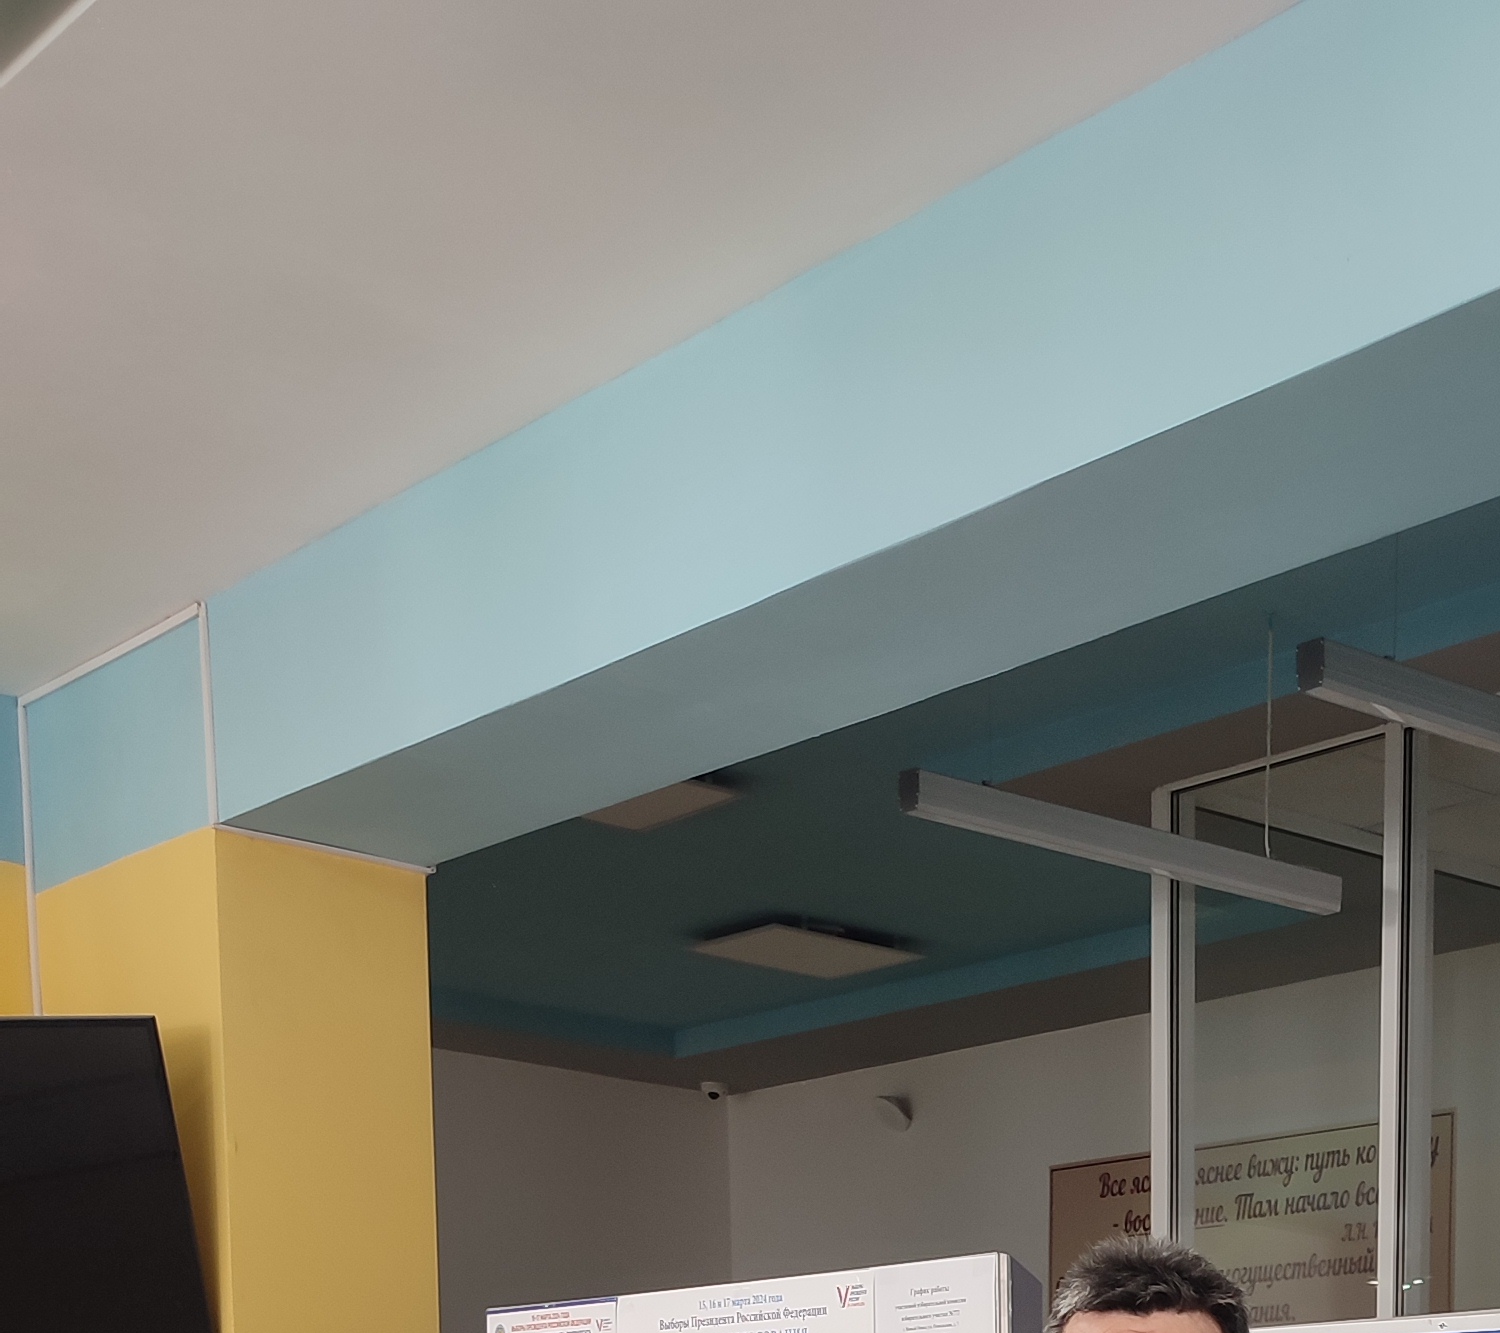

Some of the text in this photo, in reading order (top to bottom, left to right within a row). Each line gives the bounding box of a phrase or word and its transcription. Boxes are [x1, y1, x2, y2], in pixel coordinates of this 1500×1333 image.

[1098, 1172, 1127, 1199] Все
[1195, 1162, 1243, 1186] яснее
[1246, 1154, 1300, 1188] вижу:
[1304, 1147, 1351, 1184] путь
[1235, 1192, 1279, 1221] Там
[1284, 1189, 1349, 1216] начало
[659, 1317, 690, 1332] Выборы
[691, 1312, 735, 1328] Президента
